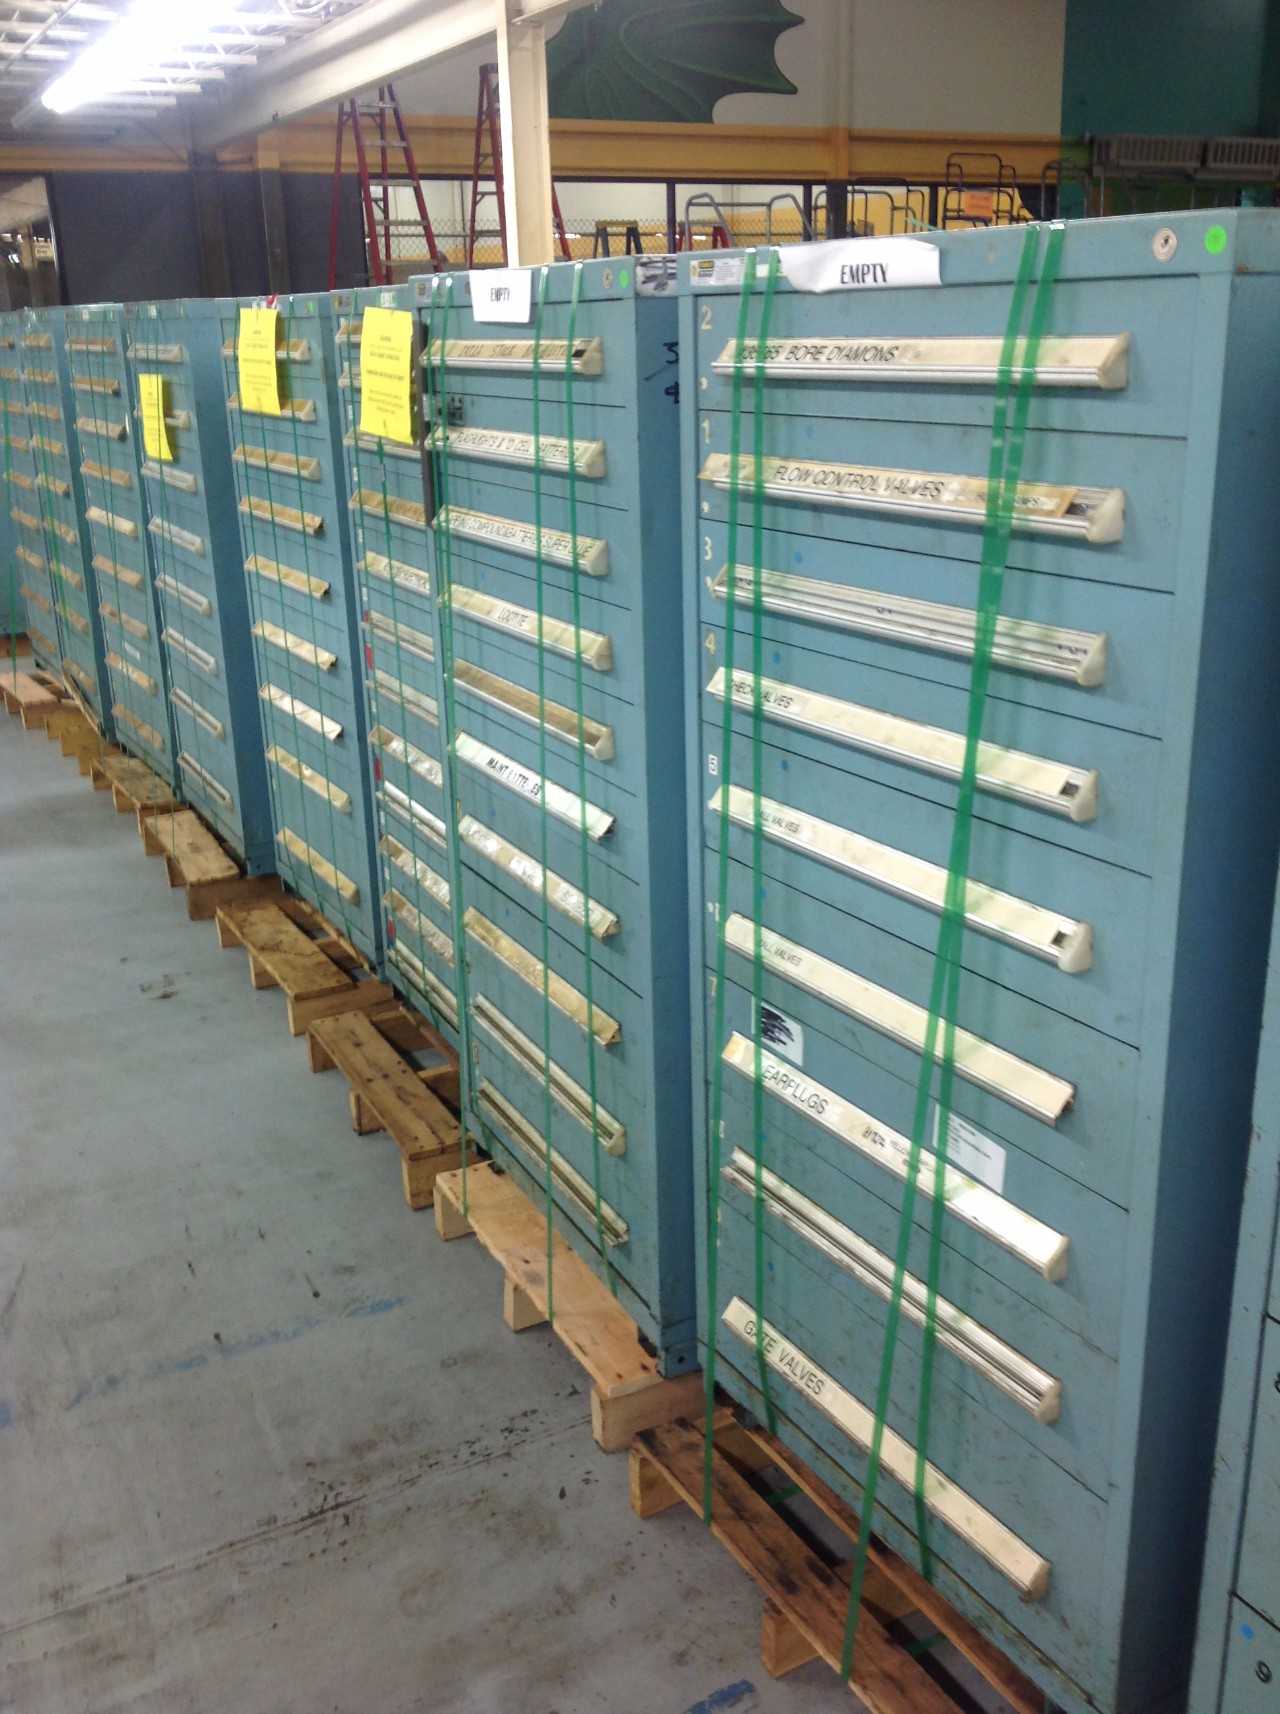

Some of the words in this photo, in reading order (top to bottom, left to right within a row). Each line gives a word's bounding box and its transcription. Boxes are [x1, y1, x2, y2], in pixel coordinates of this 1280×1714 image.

[840, 262, 888, 285] EMPTY
[490, 287, 510, 302] EMPTY
[701, 305, 713, 330] 2
[783, 345, 826, 362] BORE
[826, 346, 899, 362] DIAMONS
[774, 464, 812, 483] FLOW
[812, 469, 880, 492] CONTROL
[881, 479, 945, 498] VALVES
[704, 632, 716, 655] 4
[762, 1064, 829, 1115] EARPLUGS
[779, 1347, 825, 1395] VALVES
